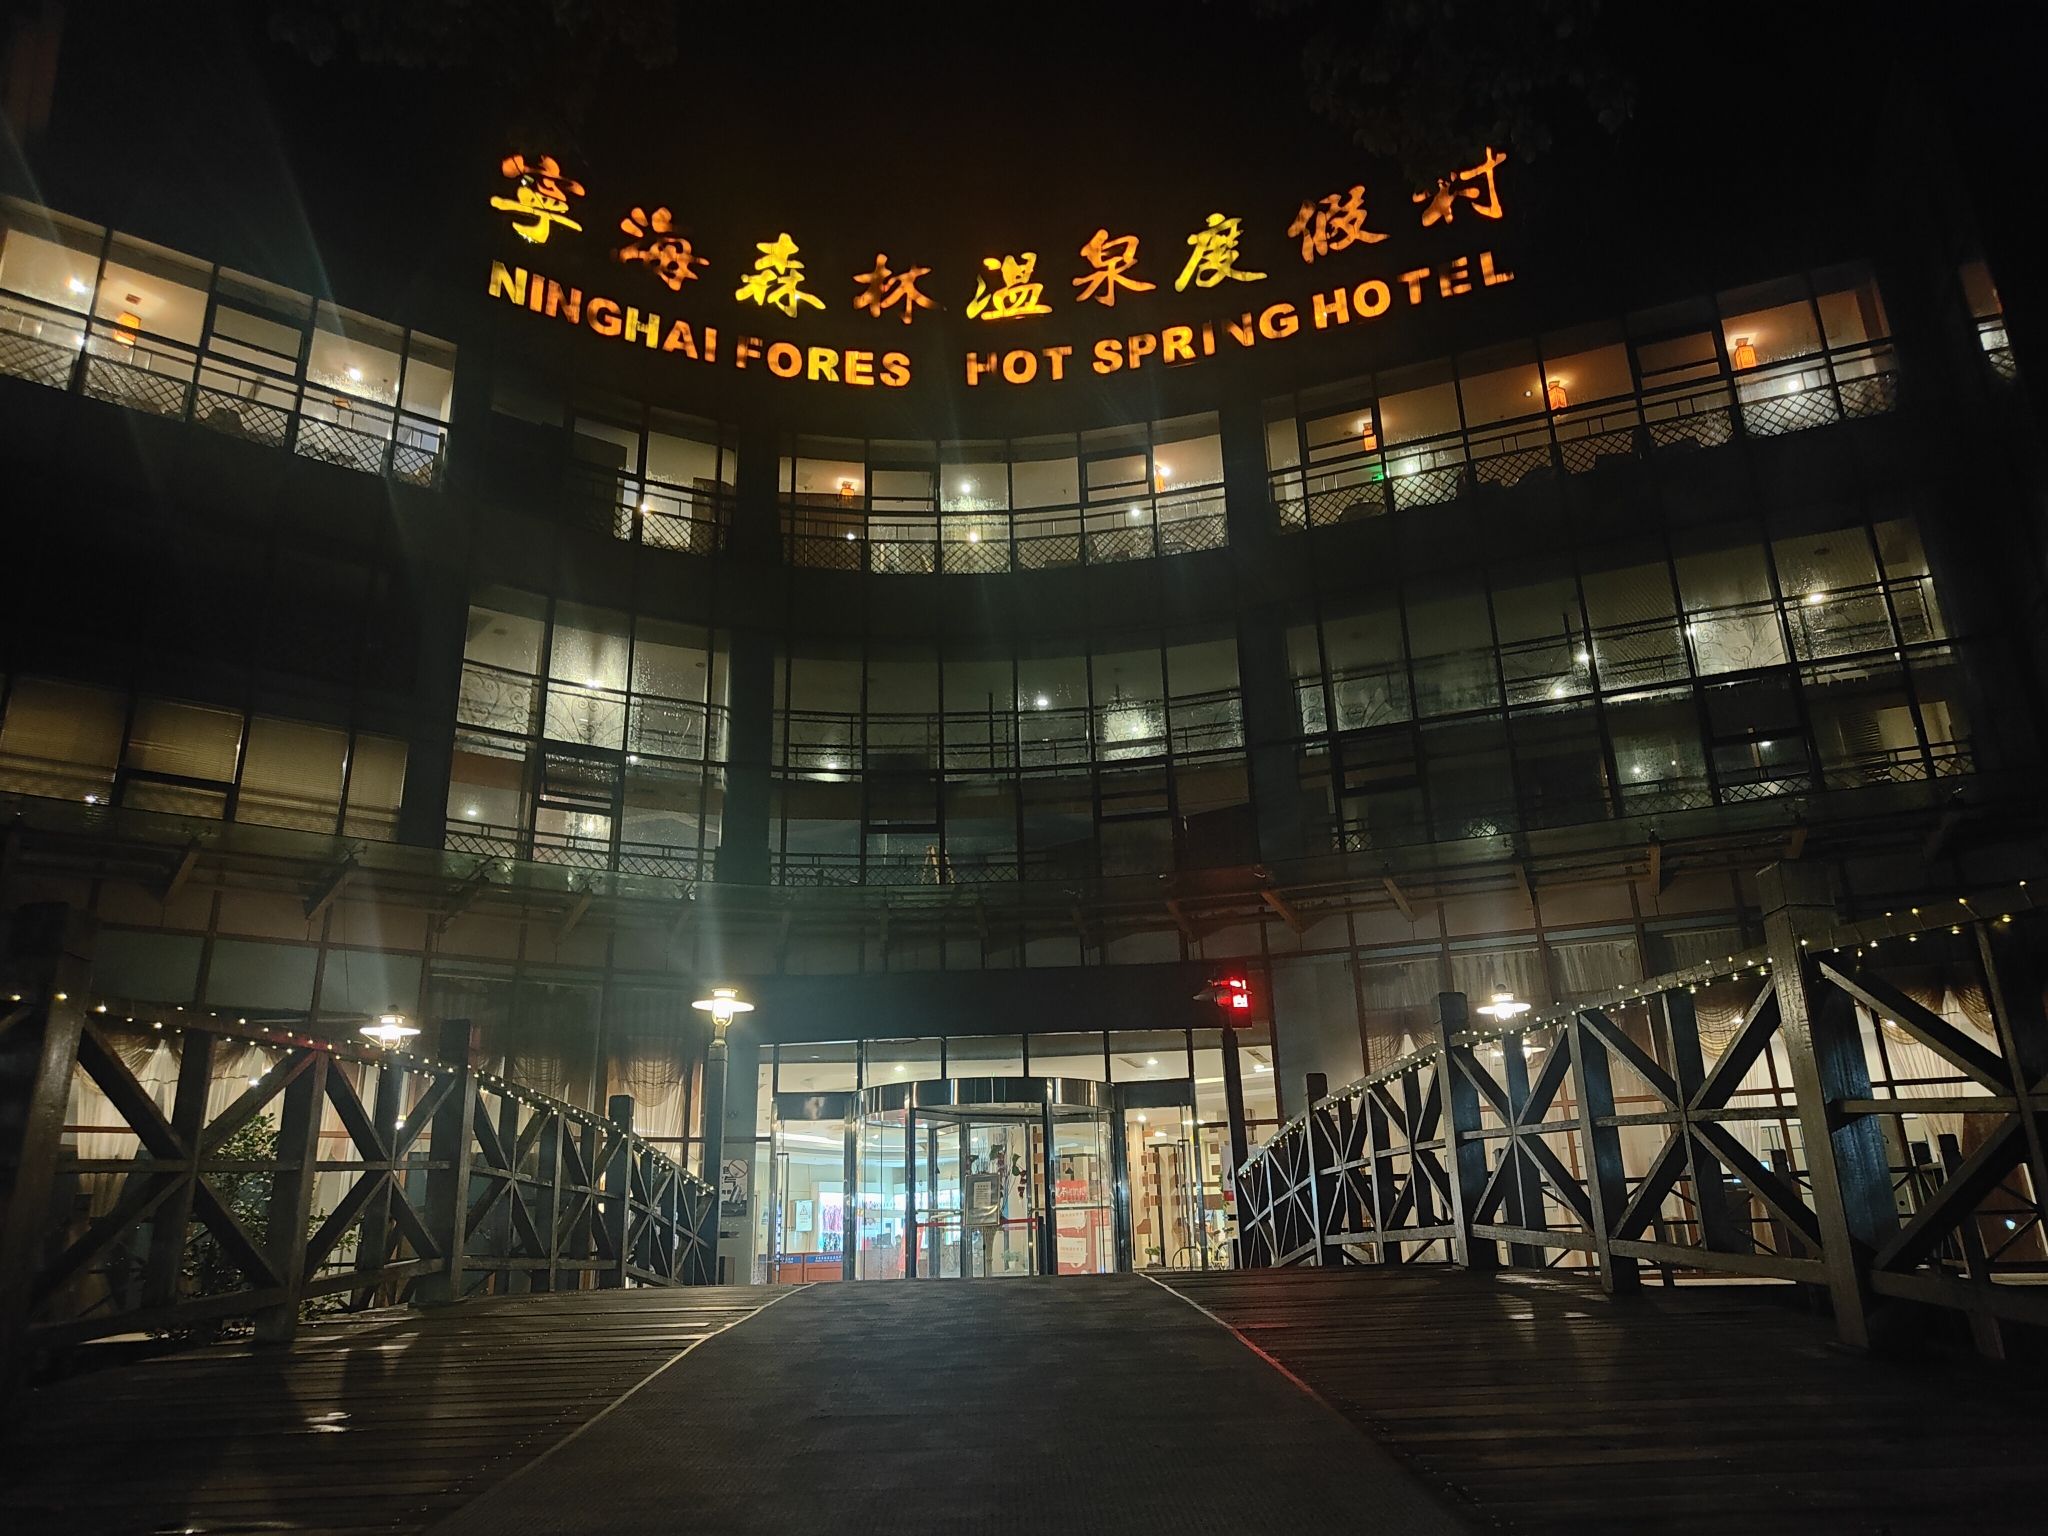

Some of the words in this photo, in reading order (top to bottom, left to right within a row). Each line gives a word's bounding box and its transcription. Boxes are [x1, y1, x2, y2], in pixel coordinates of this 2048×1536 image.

[488, 263, 718, 363] NINGHAI
[735, 338, 911, 386] FORES
[966, 345, 1073, 385] HOT
[1092, 302, 1299, 374] SPRING
[1312, 251, 1514, 329] HOTEL
